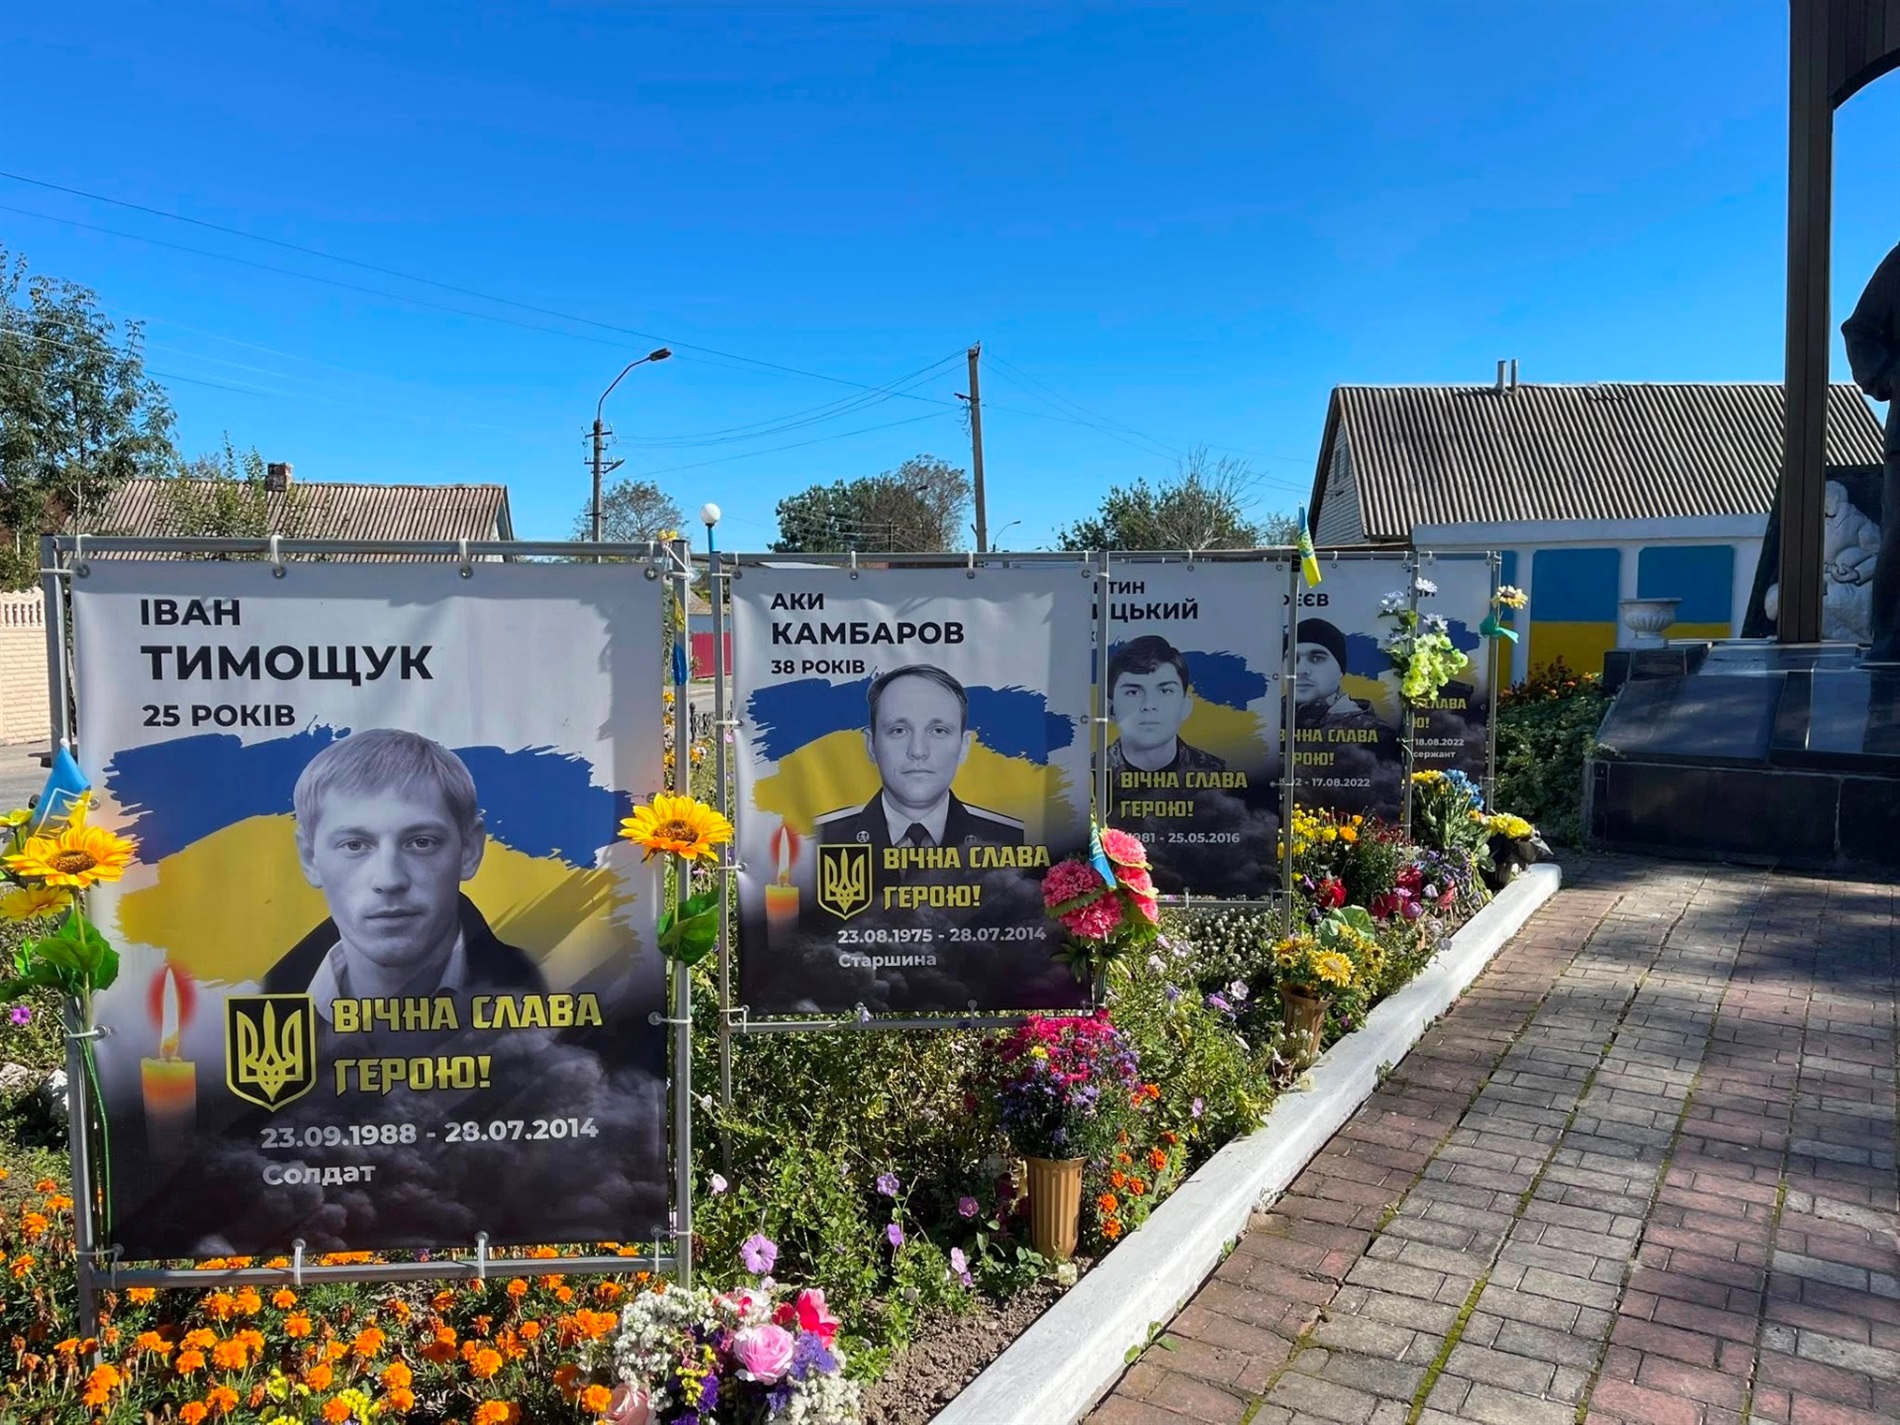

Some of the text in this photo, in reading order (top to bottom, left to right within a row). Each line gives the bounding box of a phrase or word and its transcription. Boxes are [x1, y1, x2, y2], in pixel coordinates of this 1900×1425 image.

[770, 593, 824, 610] АКИ
[140, 599, 241, 626] ІВАН
[772, 622, 965, 645] КАМБАРОВ
[140, 645, 434, 687] ТИМОЩУК
[771, 660, 865, 674] 38 РОКІВ
[1424, 698, 1467, 709] СЛАВА
[142, 704, 296, 727] 25 РОКІВ
[1328, 729, 1379, 743] СЛАВА
[1415, 738, 1464, 746] 18.08.2022
[1413, 751, 1456, 759] сержант
[1120, 771, 1248, 788] ВІЧНА СЛАВА
[1312, 778, 1370, 787] 17.08.2022
[1120, 801, 1194, 819] ГЕРОЮ!
[1168, 832, 1240, 843] 25.05.2016
[883, 845, 1050, 870] ВІЧНА СЛАВА
[883, 885, 982, 911] ГЕРОЮ!
[837, 929, 933, 944] 23.08.1975
[949, 926, 1047, 942] 28.07.2014
[838, 953, 937, 970] Старшина
[331, 993, 603, 1033] ВІЧНА СЛАВА
[333, 1055, 493, 1096] ГЕРОЮ!
[260, 1123, 417, 1149] 23.09.1988
[444, 1117, 599, 1143] 28.07.2014
[262, 1164, 376, 1187] Солдат
